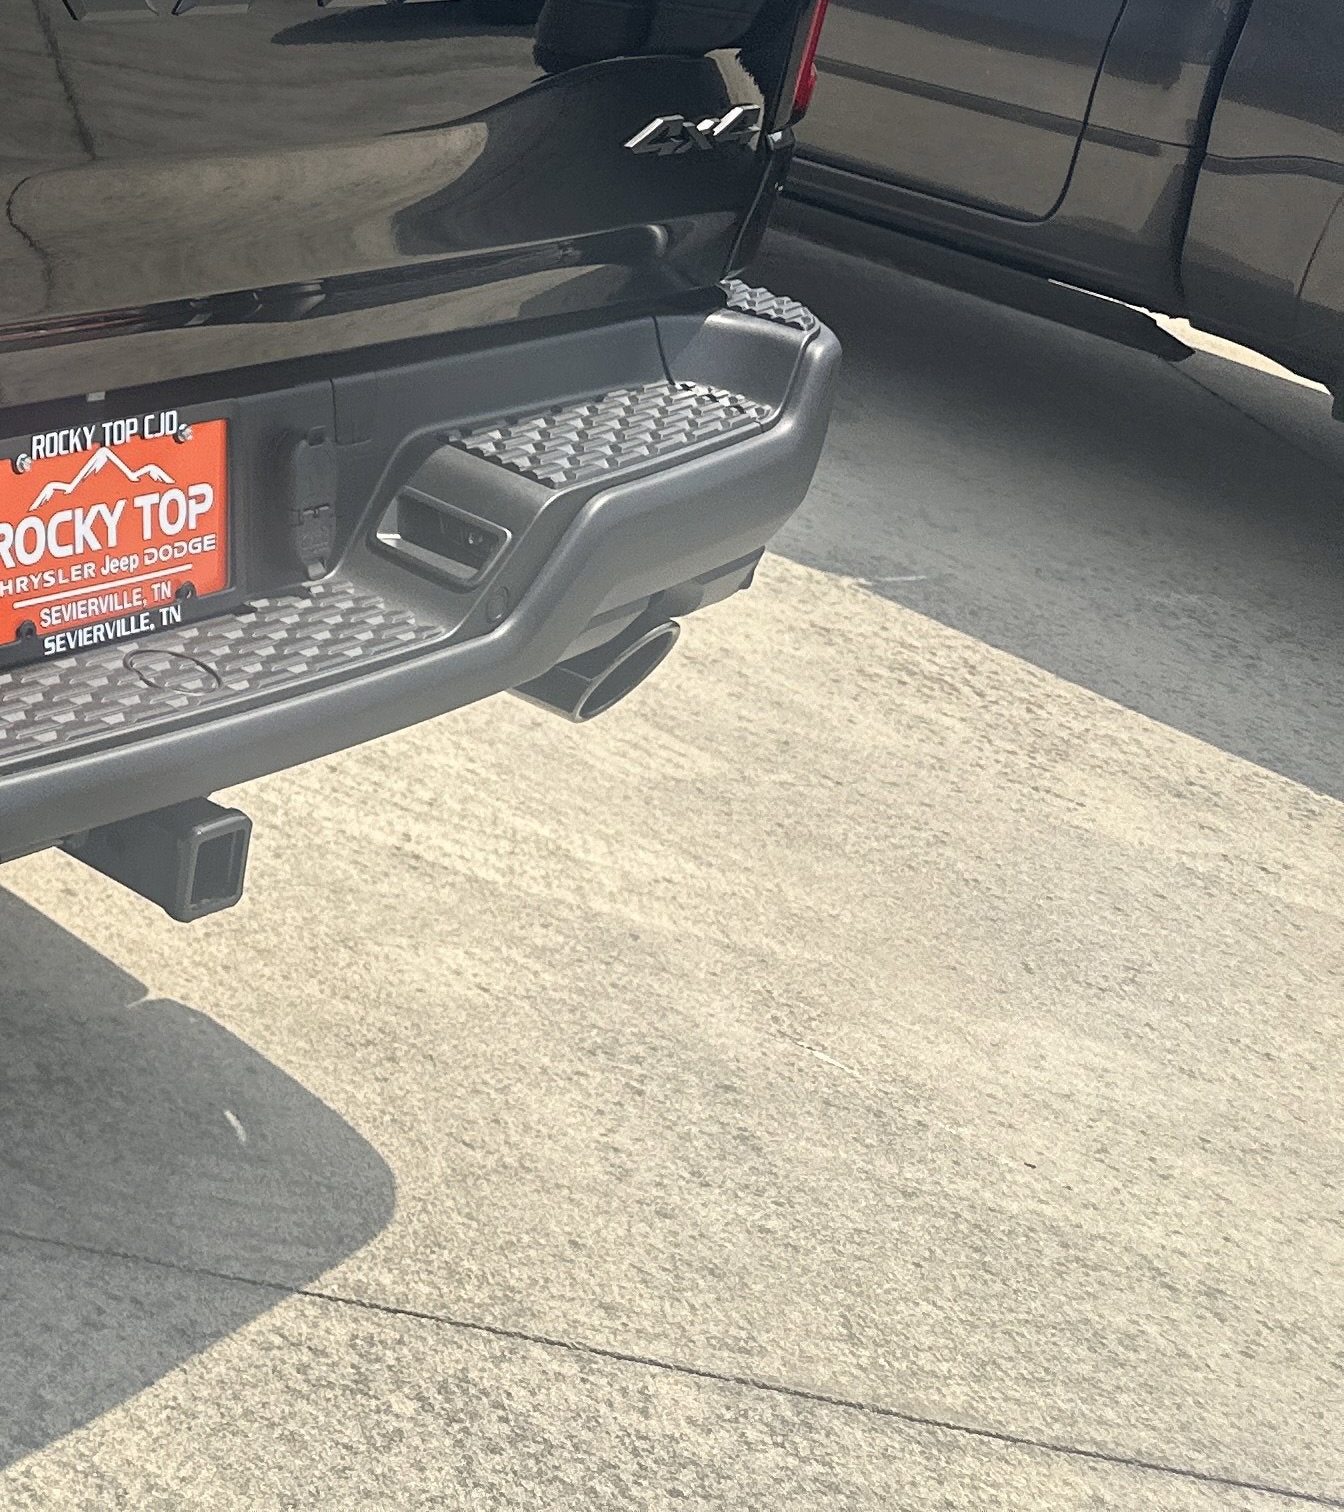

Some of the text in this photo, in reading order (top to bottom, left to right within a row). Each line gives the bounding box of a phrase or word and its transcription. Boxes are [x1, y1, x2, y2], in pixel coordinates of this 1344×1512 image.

[32, 426, 95, 460] ROCKY
[101, 417, 138, 446] TOP
[133, 483, 214, 541] TOP
[100, 552, 140, 576] Jeep
[144, 534, 216, 563] DODGE
[39, 580, 172, 628] SEVIERVILLE, TN
[43, 604, 182, 656] SEVIERVILLE, TN
